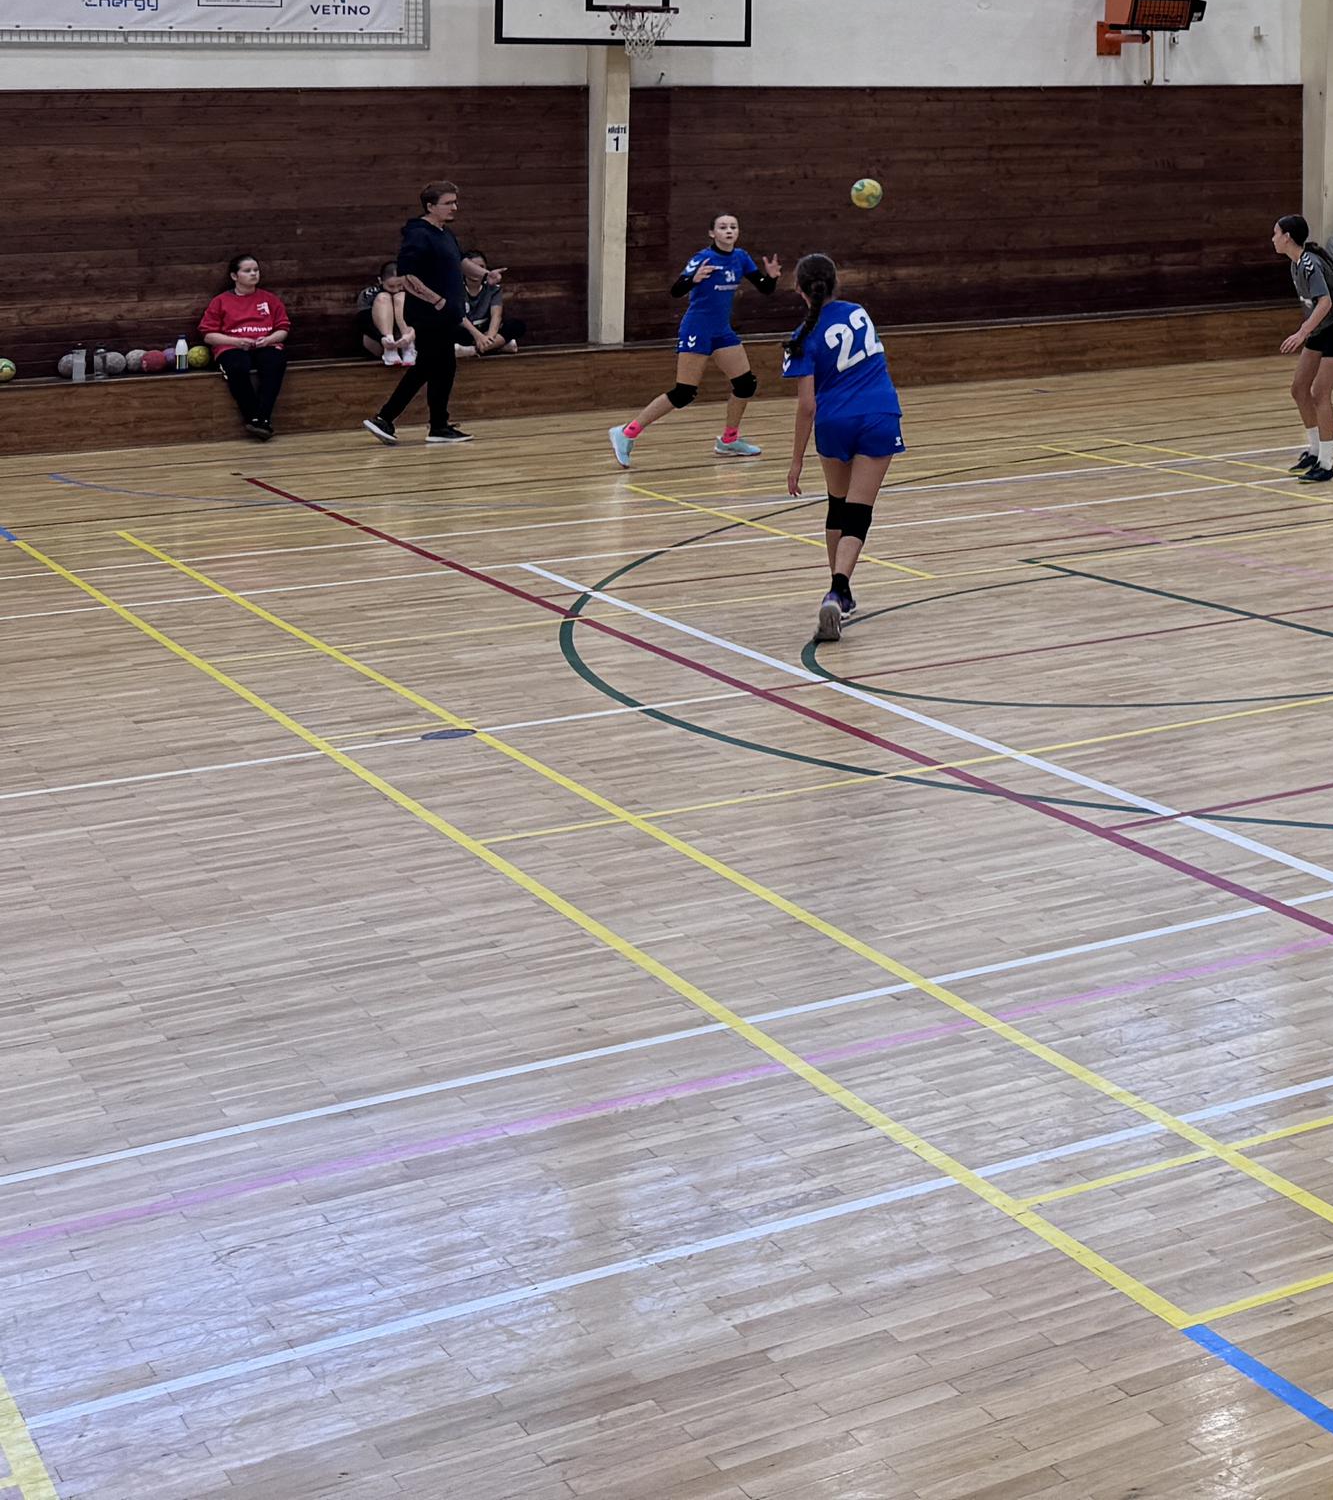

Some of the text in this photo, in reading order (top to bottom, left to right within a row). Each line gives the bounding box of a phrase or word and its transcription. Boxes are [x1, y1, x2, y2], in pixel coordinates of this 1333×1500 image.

[310, 4, 371, 16] VETINO
[613, 135, 620, 152] 1
[824, 307, 885, 373] 22
